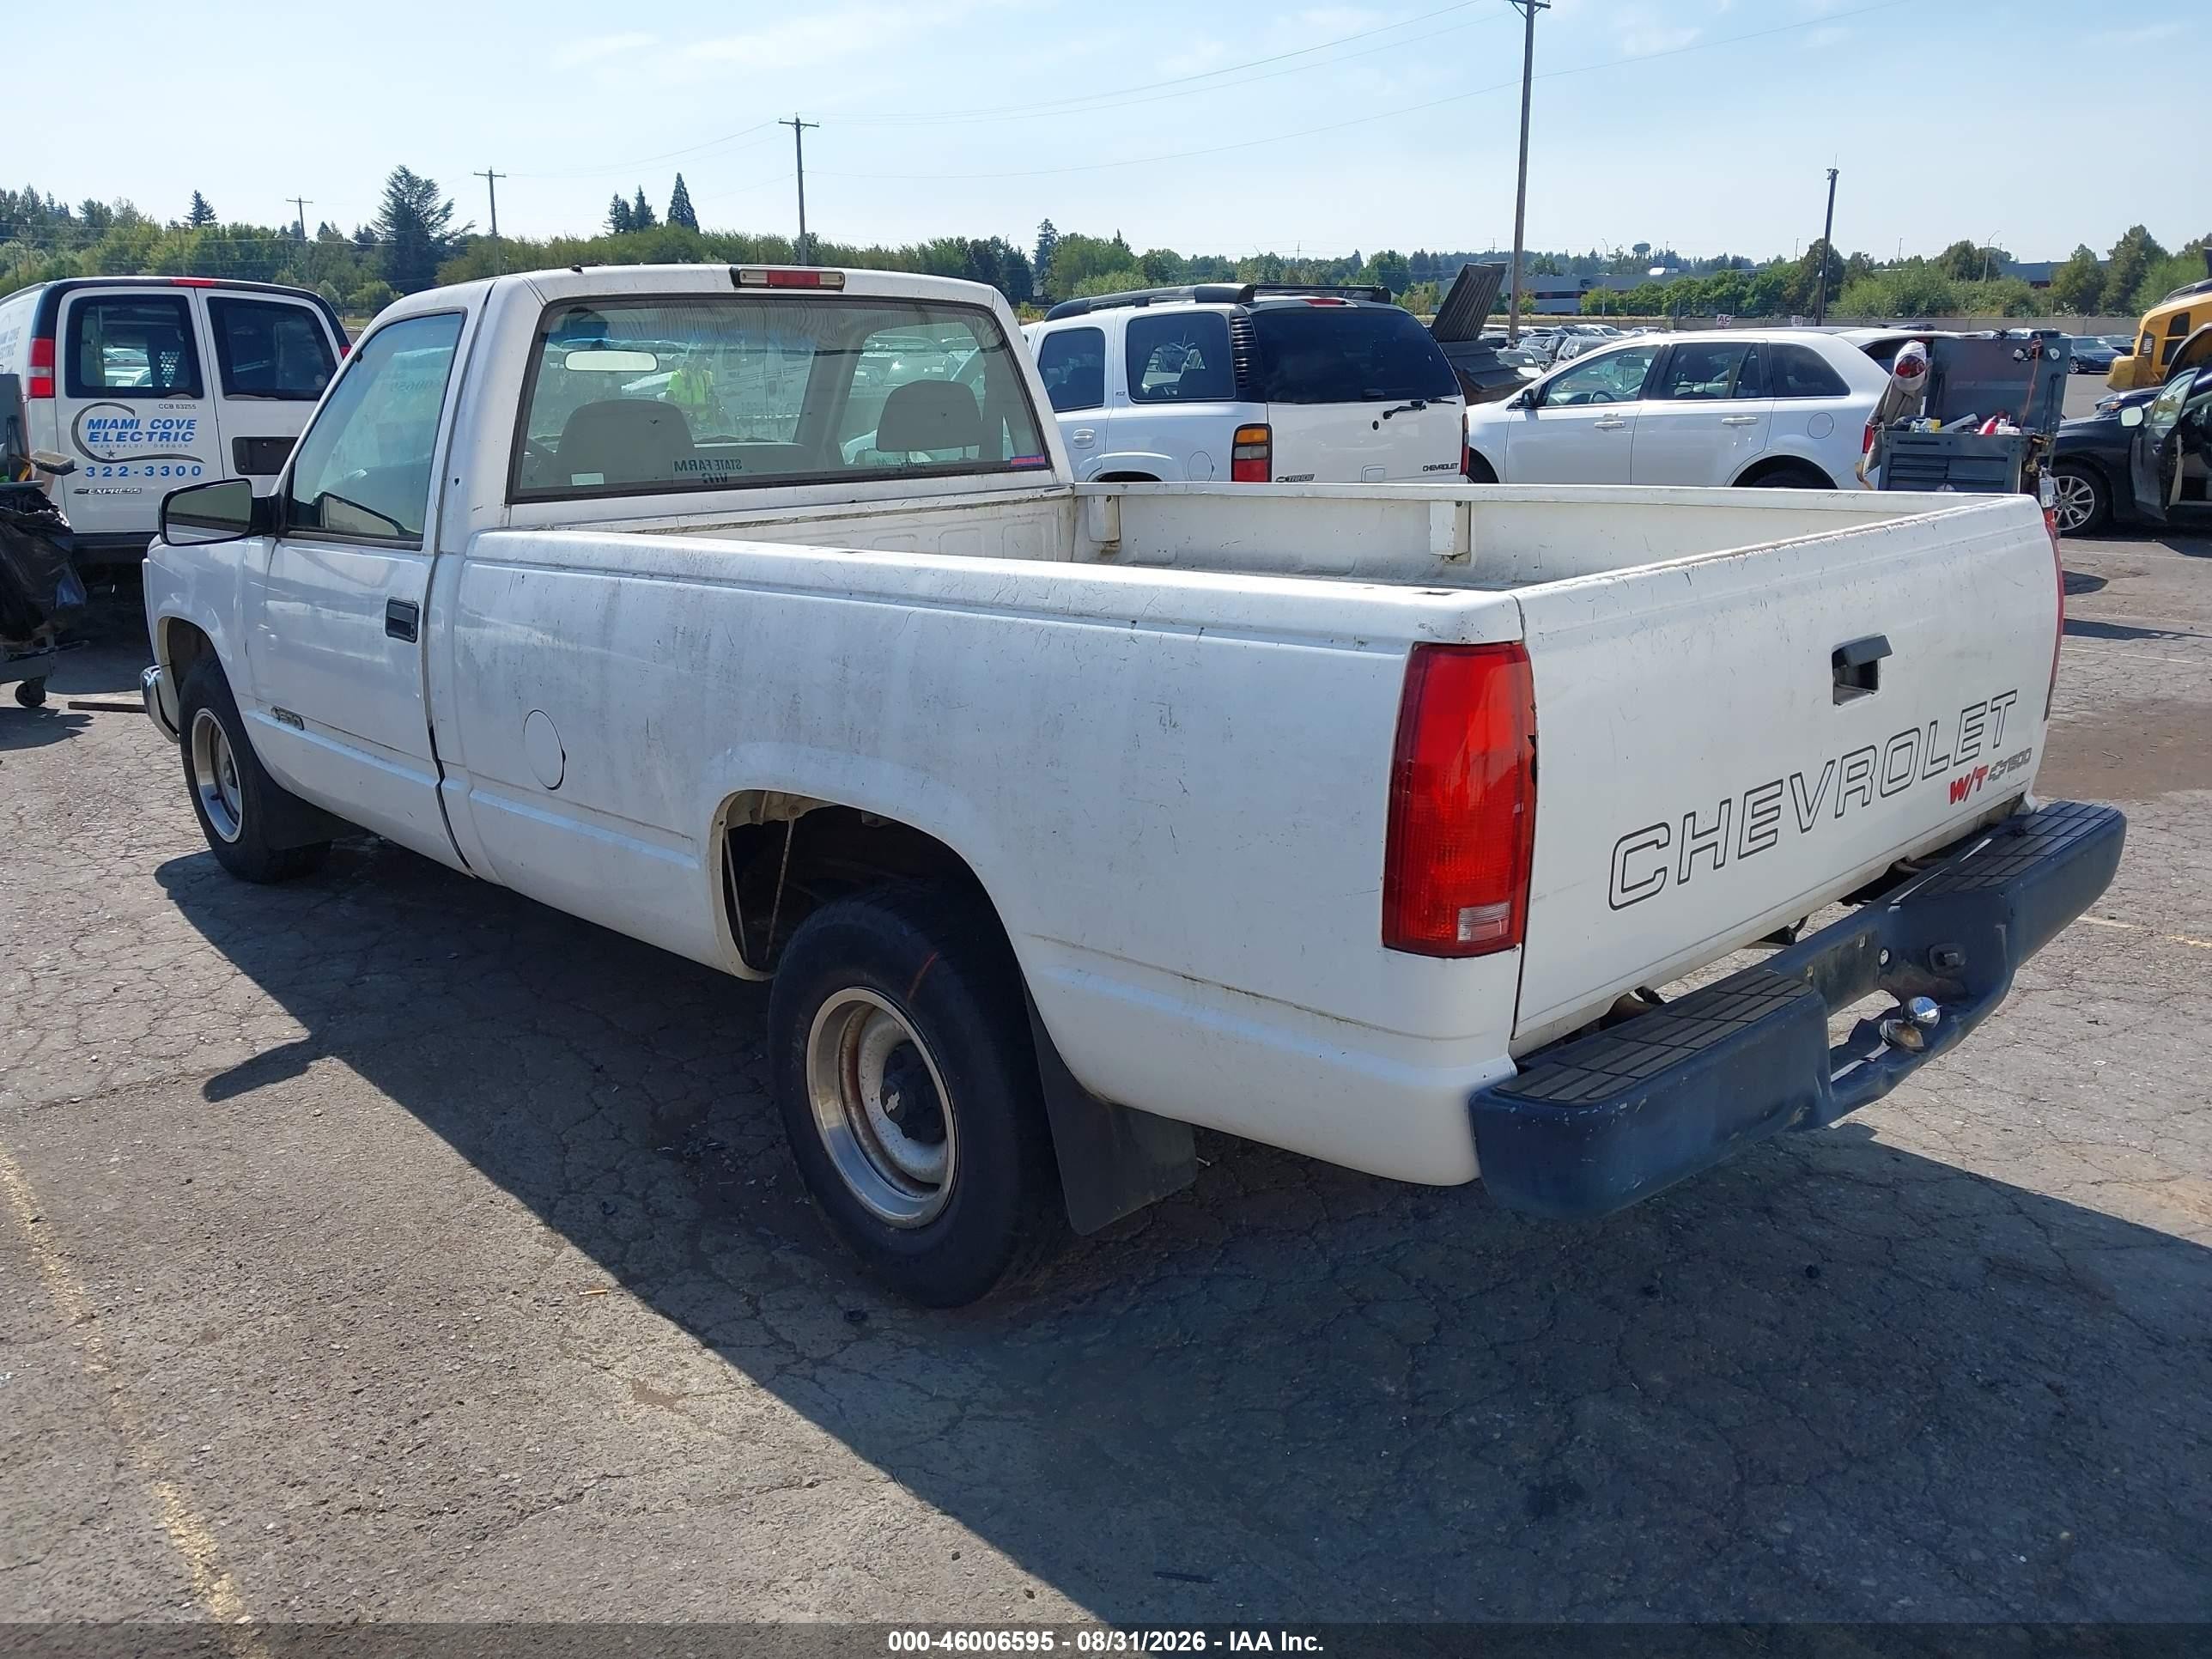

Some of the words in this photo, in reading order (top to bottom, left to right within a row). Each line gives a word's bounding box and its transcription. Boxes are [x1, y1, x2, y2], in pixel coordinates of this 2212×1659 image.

[87, 418, 141, 430] MIAMI
[149, 418, 198, 430] COVE
[88, 431, 195, 442] ELECTRIC
[85, 465, 202, 477] 322-3300
[1422, 462, 1460, 472] CHEVROLET
[87, 487, 143, 495] EXPRESS
[1949, 764, 1990, 805] W/T
[1608, 689, 2018, 911] CHEVROLET
